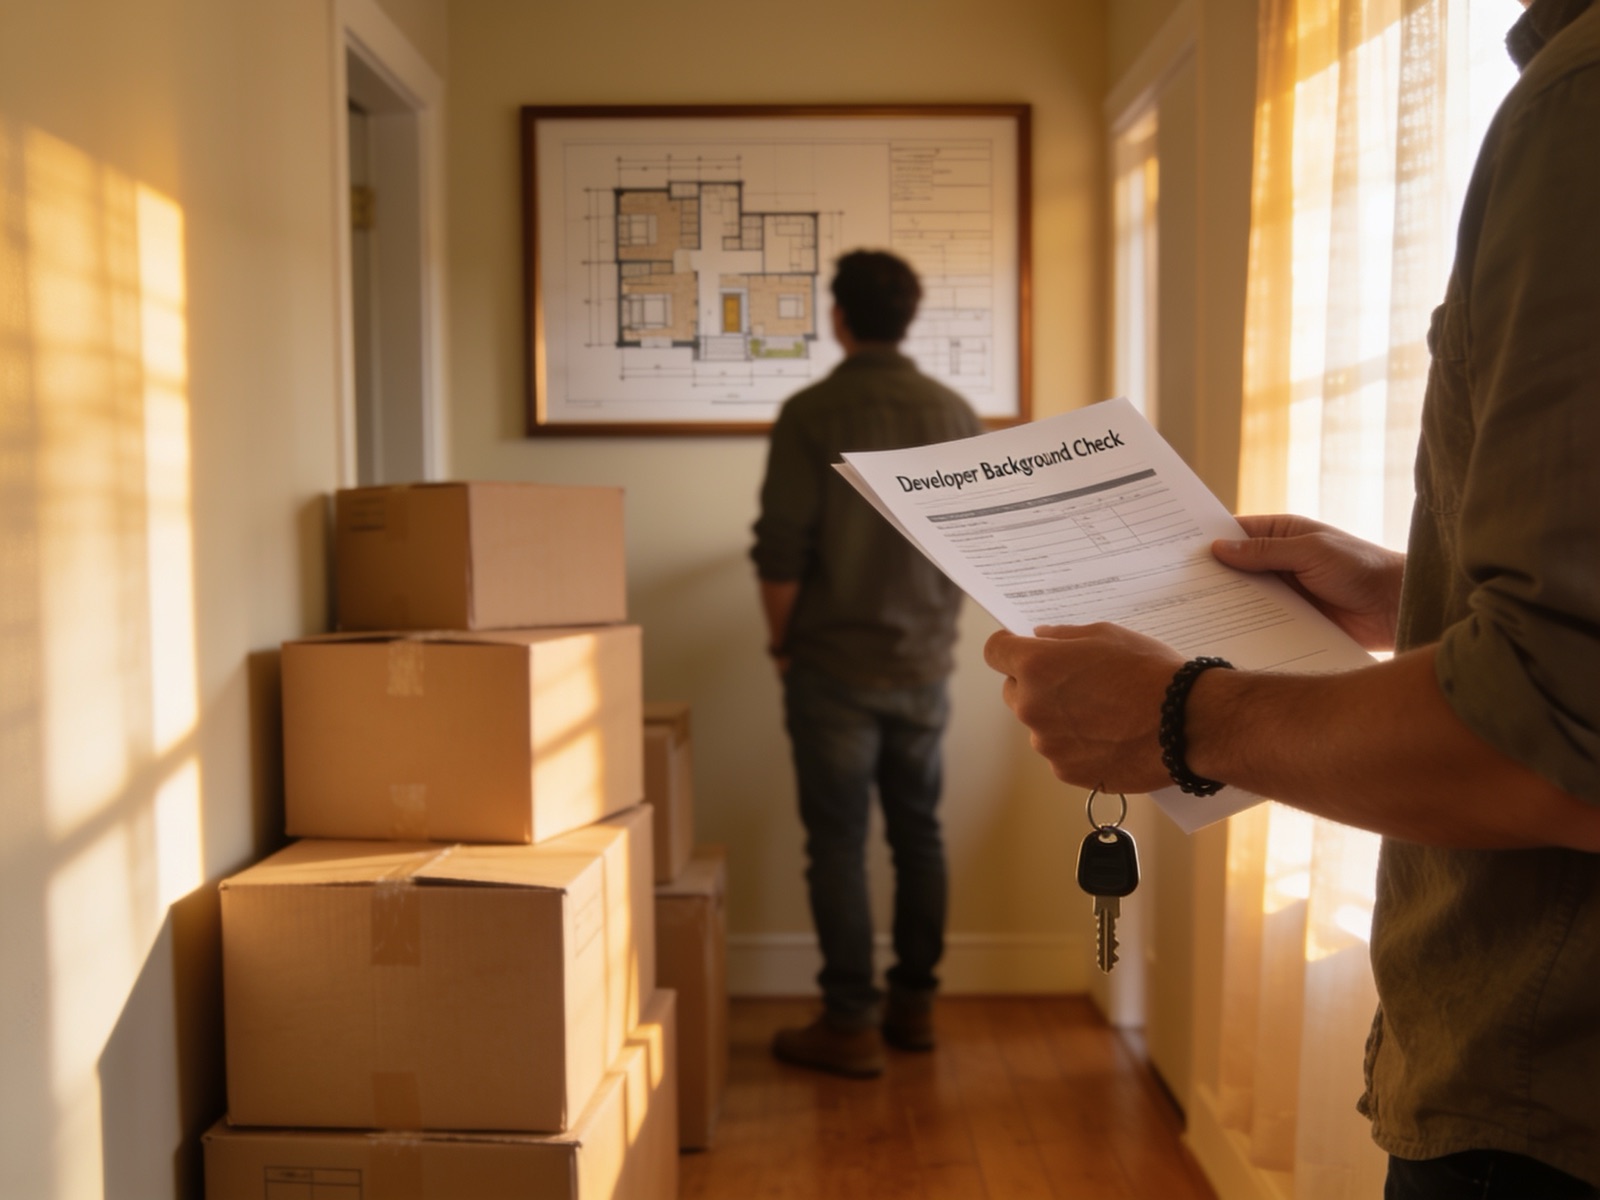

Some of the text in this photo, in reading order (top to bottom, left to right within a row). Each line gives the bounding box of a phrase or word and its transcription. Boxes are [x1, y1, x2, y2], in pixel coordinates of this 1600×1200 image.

[896, 429, 1125, 492] Developer Background Check
